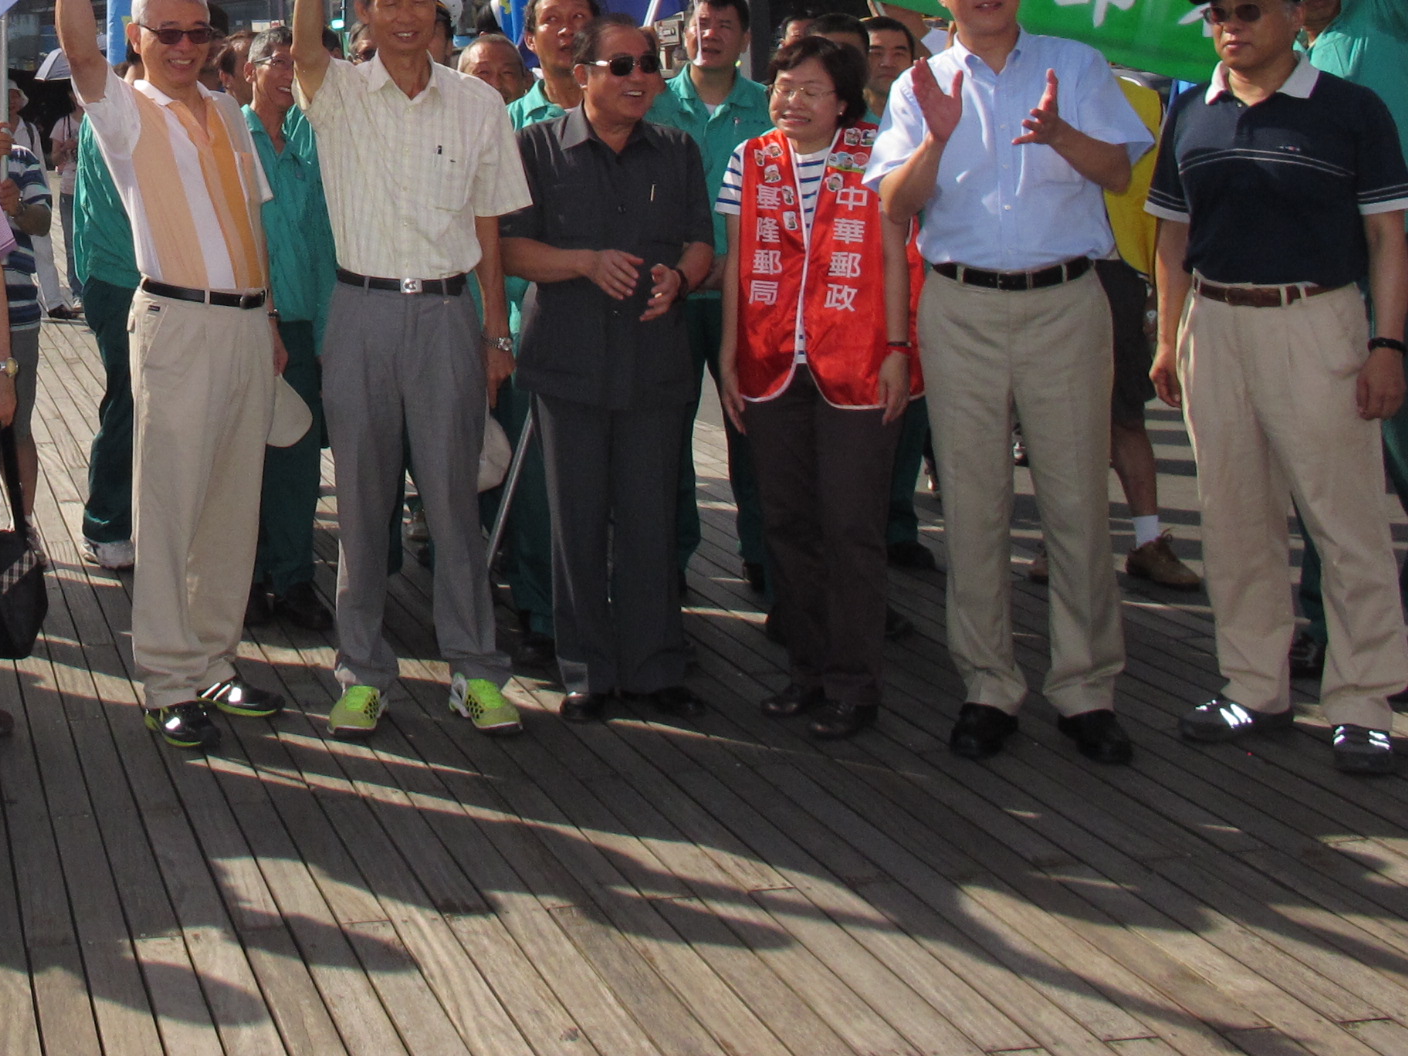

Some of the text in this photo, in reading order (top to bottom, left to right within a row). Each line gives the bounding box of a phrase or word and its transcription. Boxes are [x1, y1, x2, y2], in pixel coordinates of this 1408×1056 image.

[748, 183, 784, 307] 基隆郵局
[823, 185, 869, 313] 中華郵政
